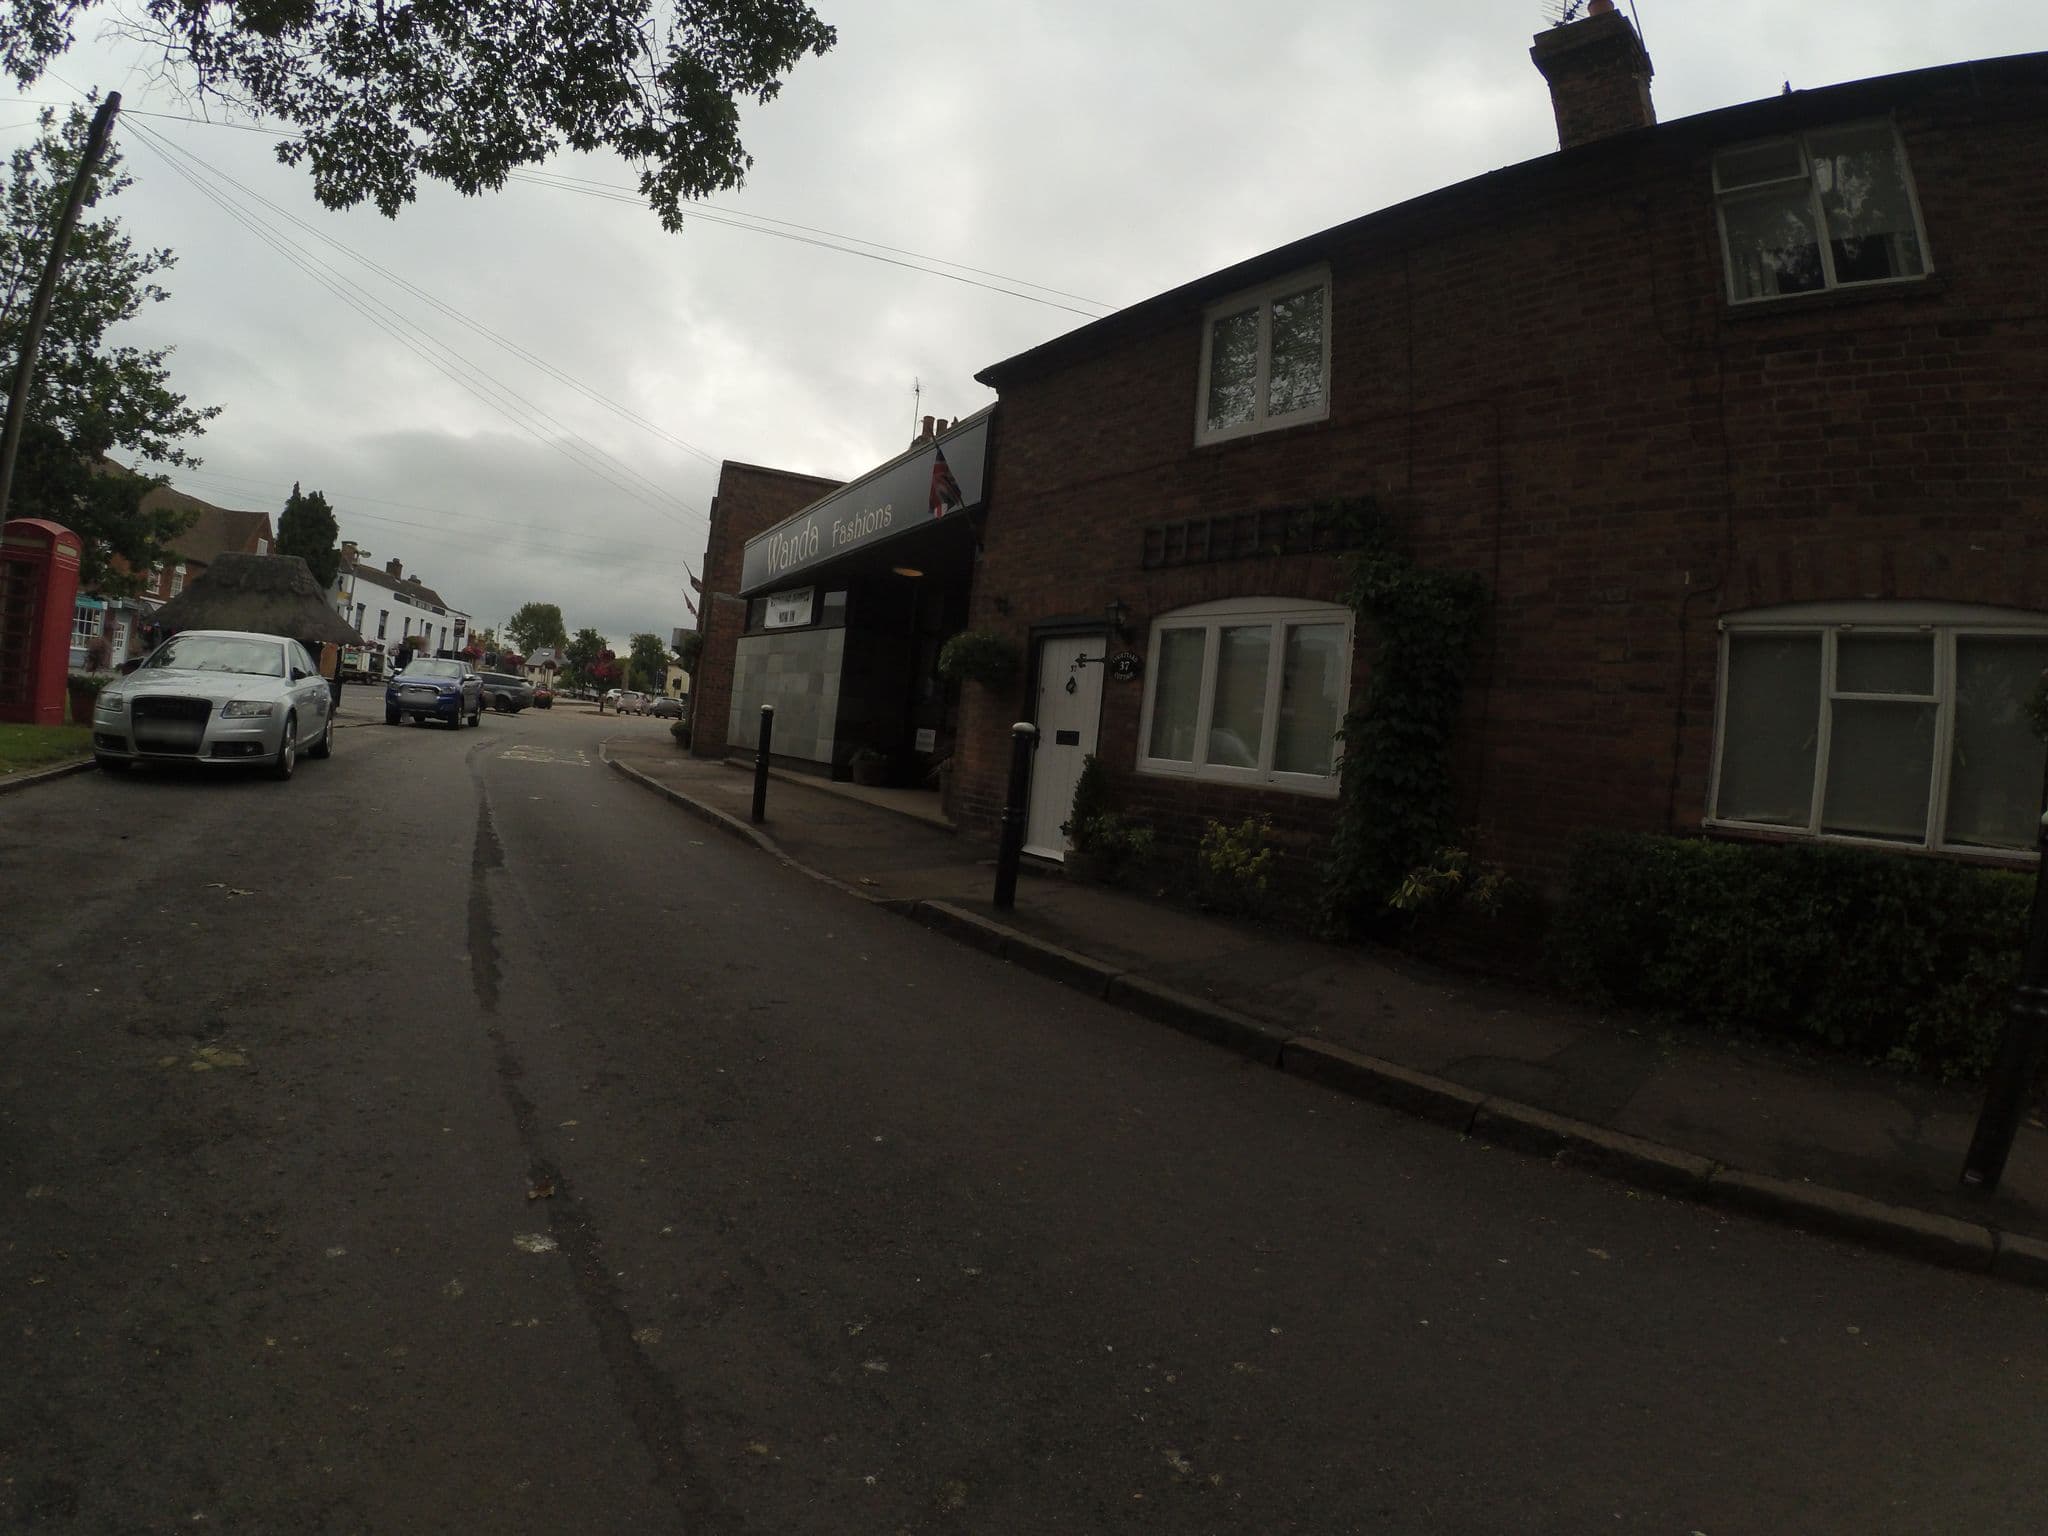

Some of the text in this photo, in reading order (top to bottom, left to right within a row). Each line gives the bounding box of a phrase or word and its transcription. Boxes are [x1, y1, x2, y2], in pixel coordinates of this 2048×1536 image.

[767, 503, 893, 576] Wanda Fashions
[1119, 660, 1131, 672] 37
